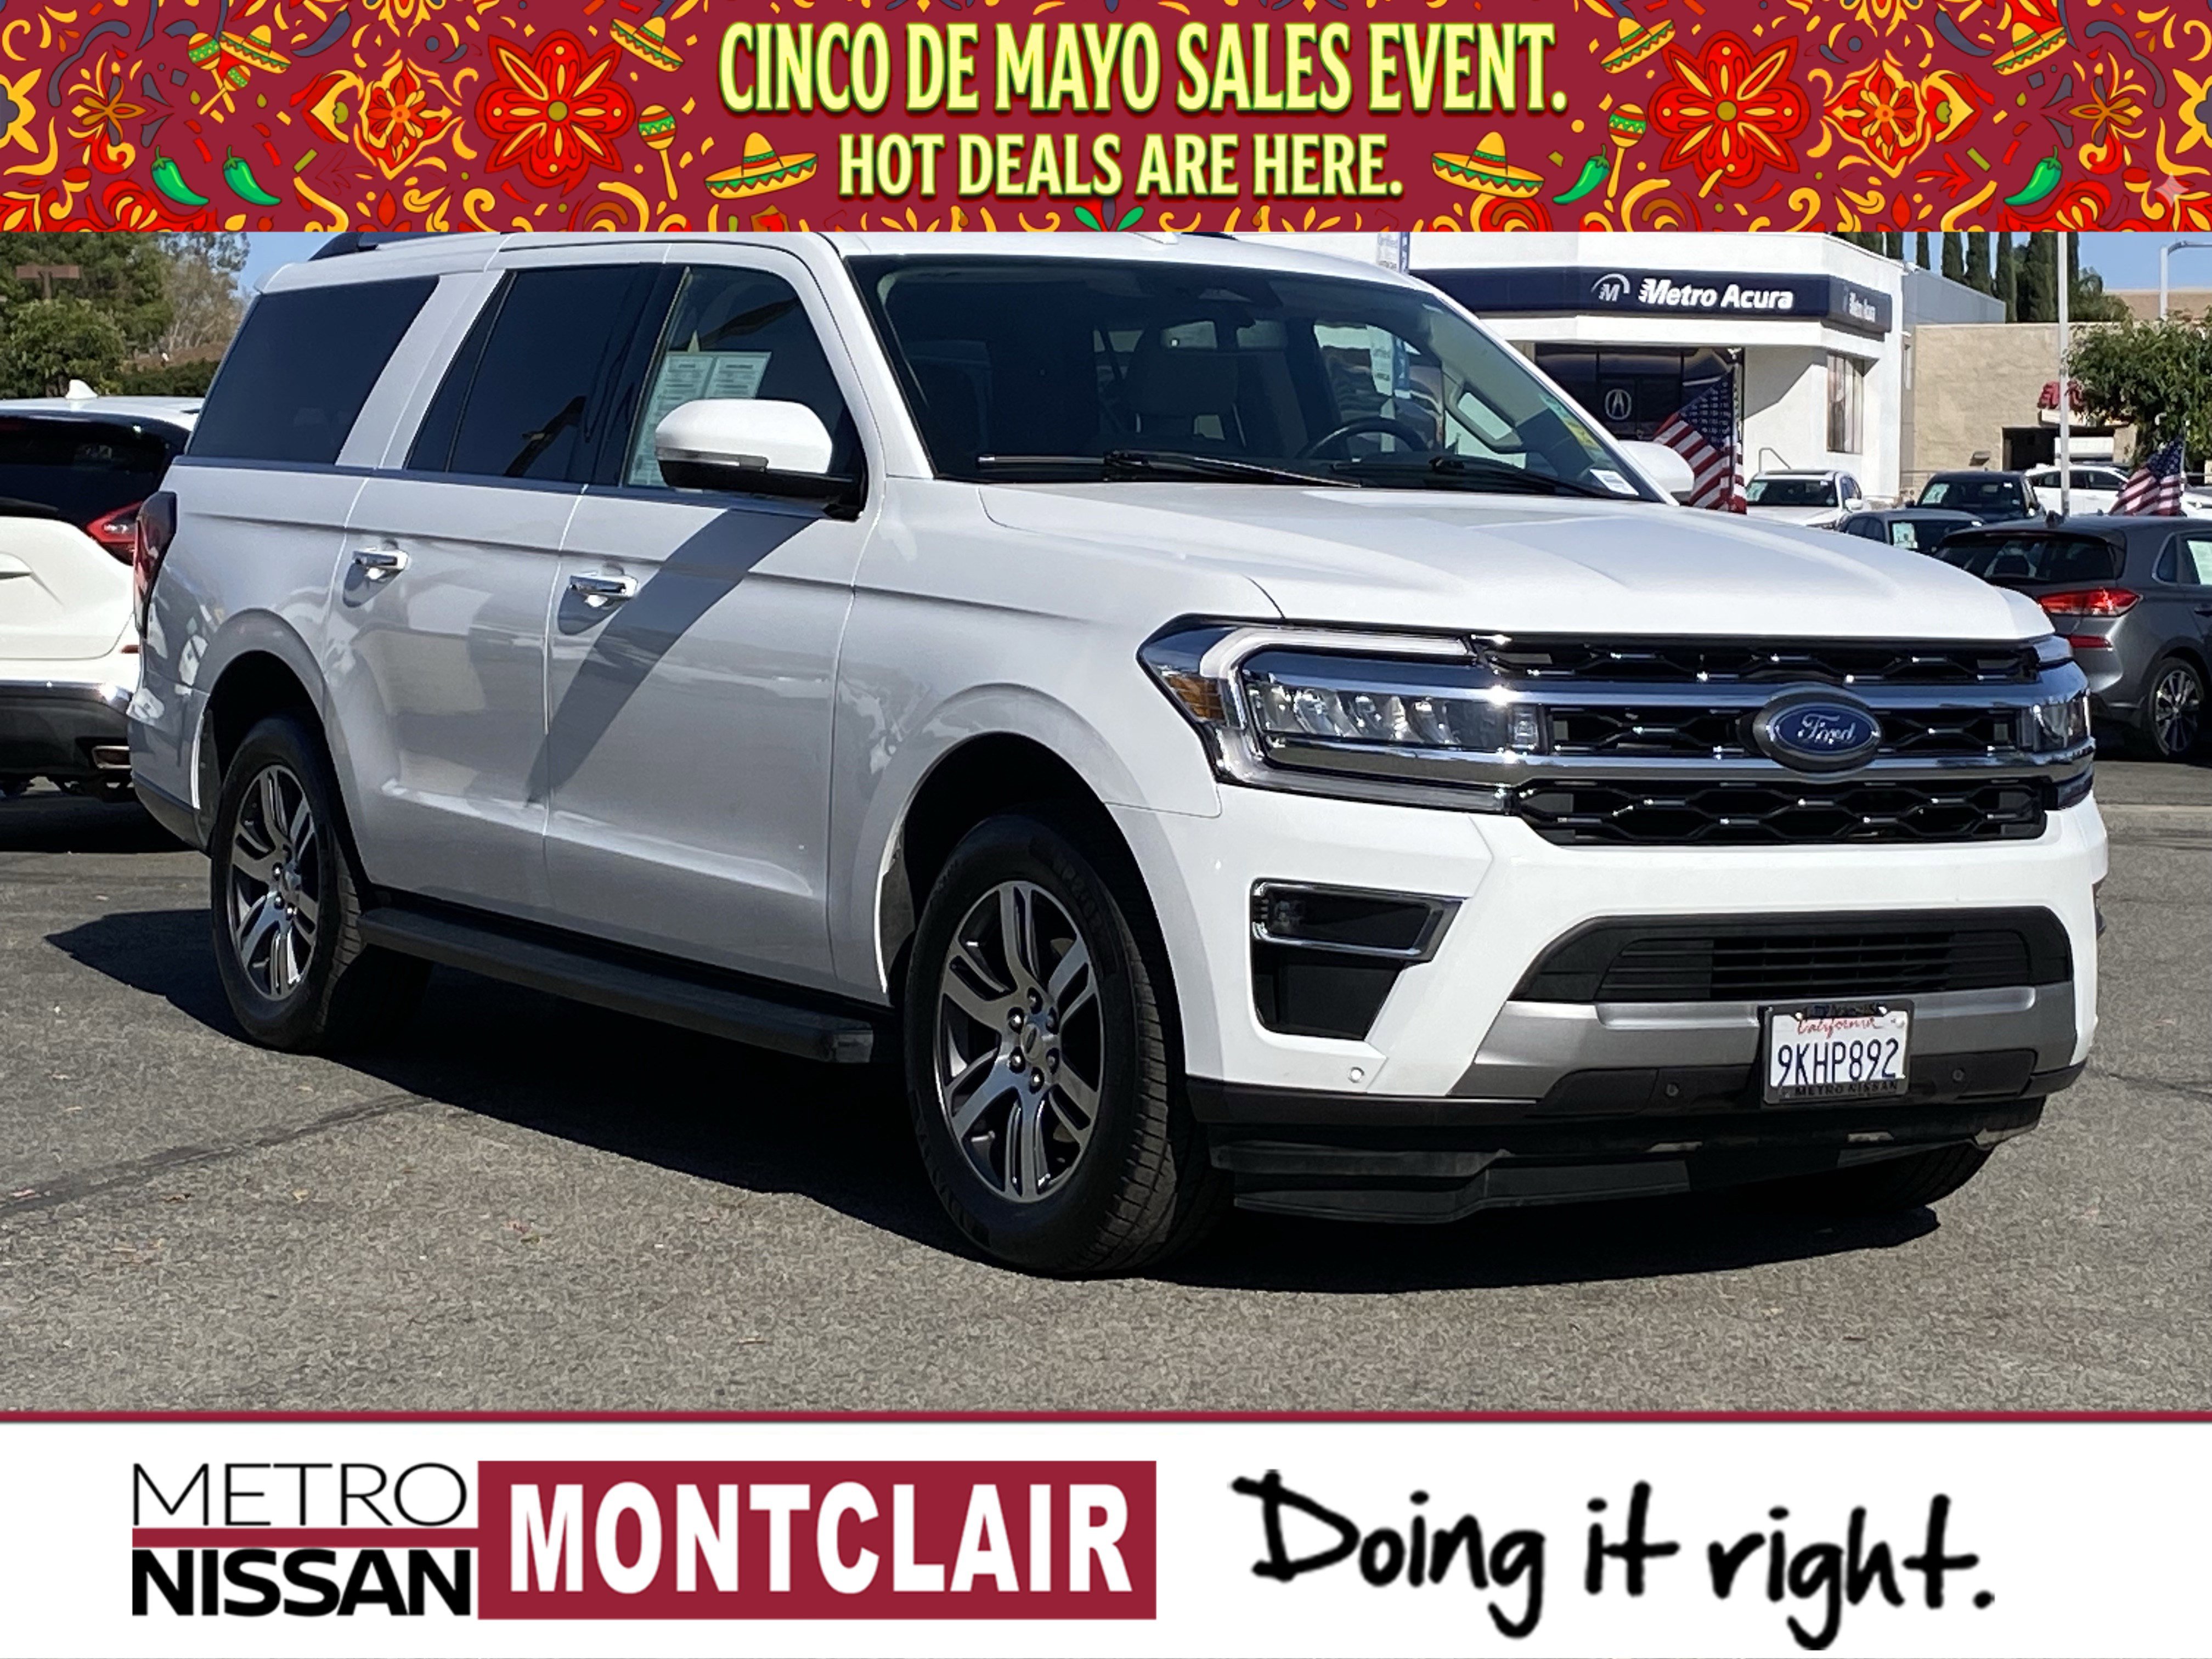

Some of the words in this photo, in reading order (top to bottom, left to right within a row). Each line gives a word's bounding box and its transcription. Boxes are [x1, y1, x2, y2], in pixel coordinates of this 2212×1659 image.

[1638, 278, 1718, 307] Metro
[1720, 284, 1793, 309] Acura
[1797, 713, 1857, 744] Ford
[1778, 1037, 1898, 1086] 9KHP892
[1848, 1082, 1898, 1092] NISSAN
